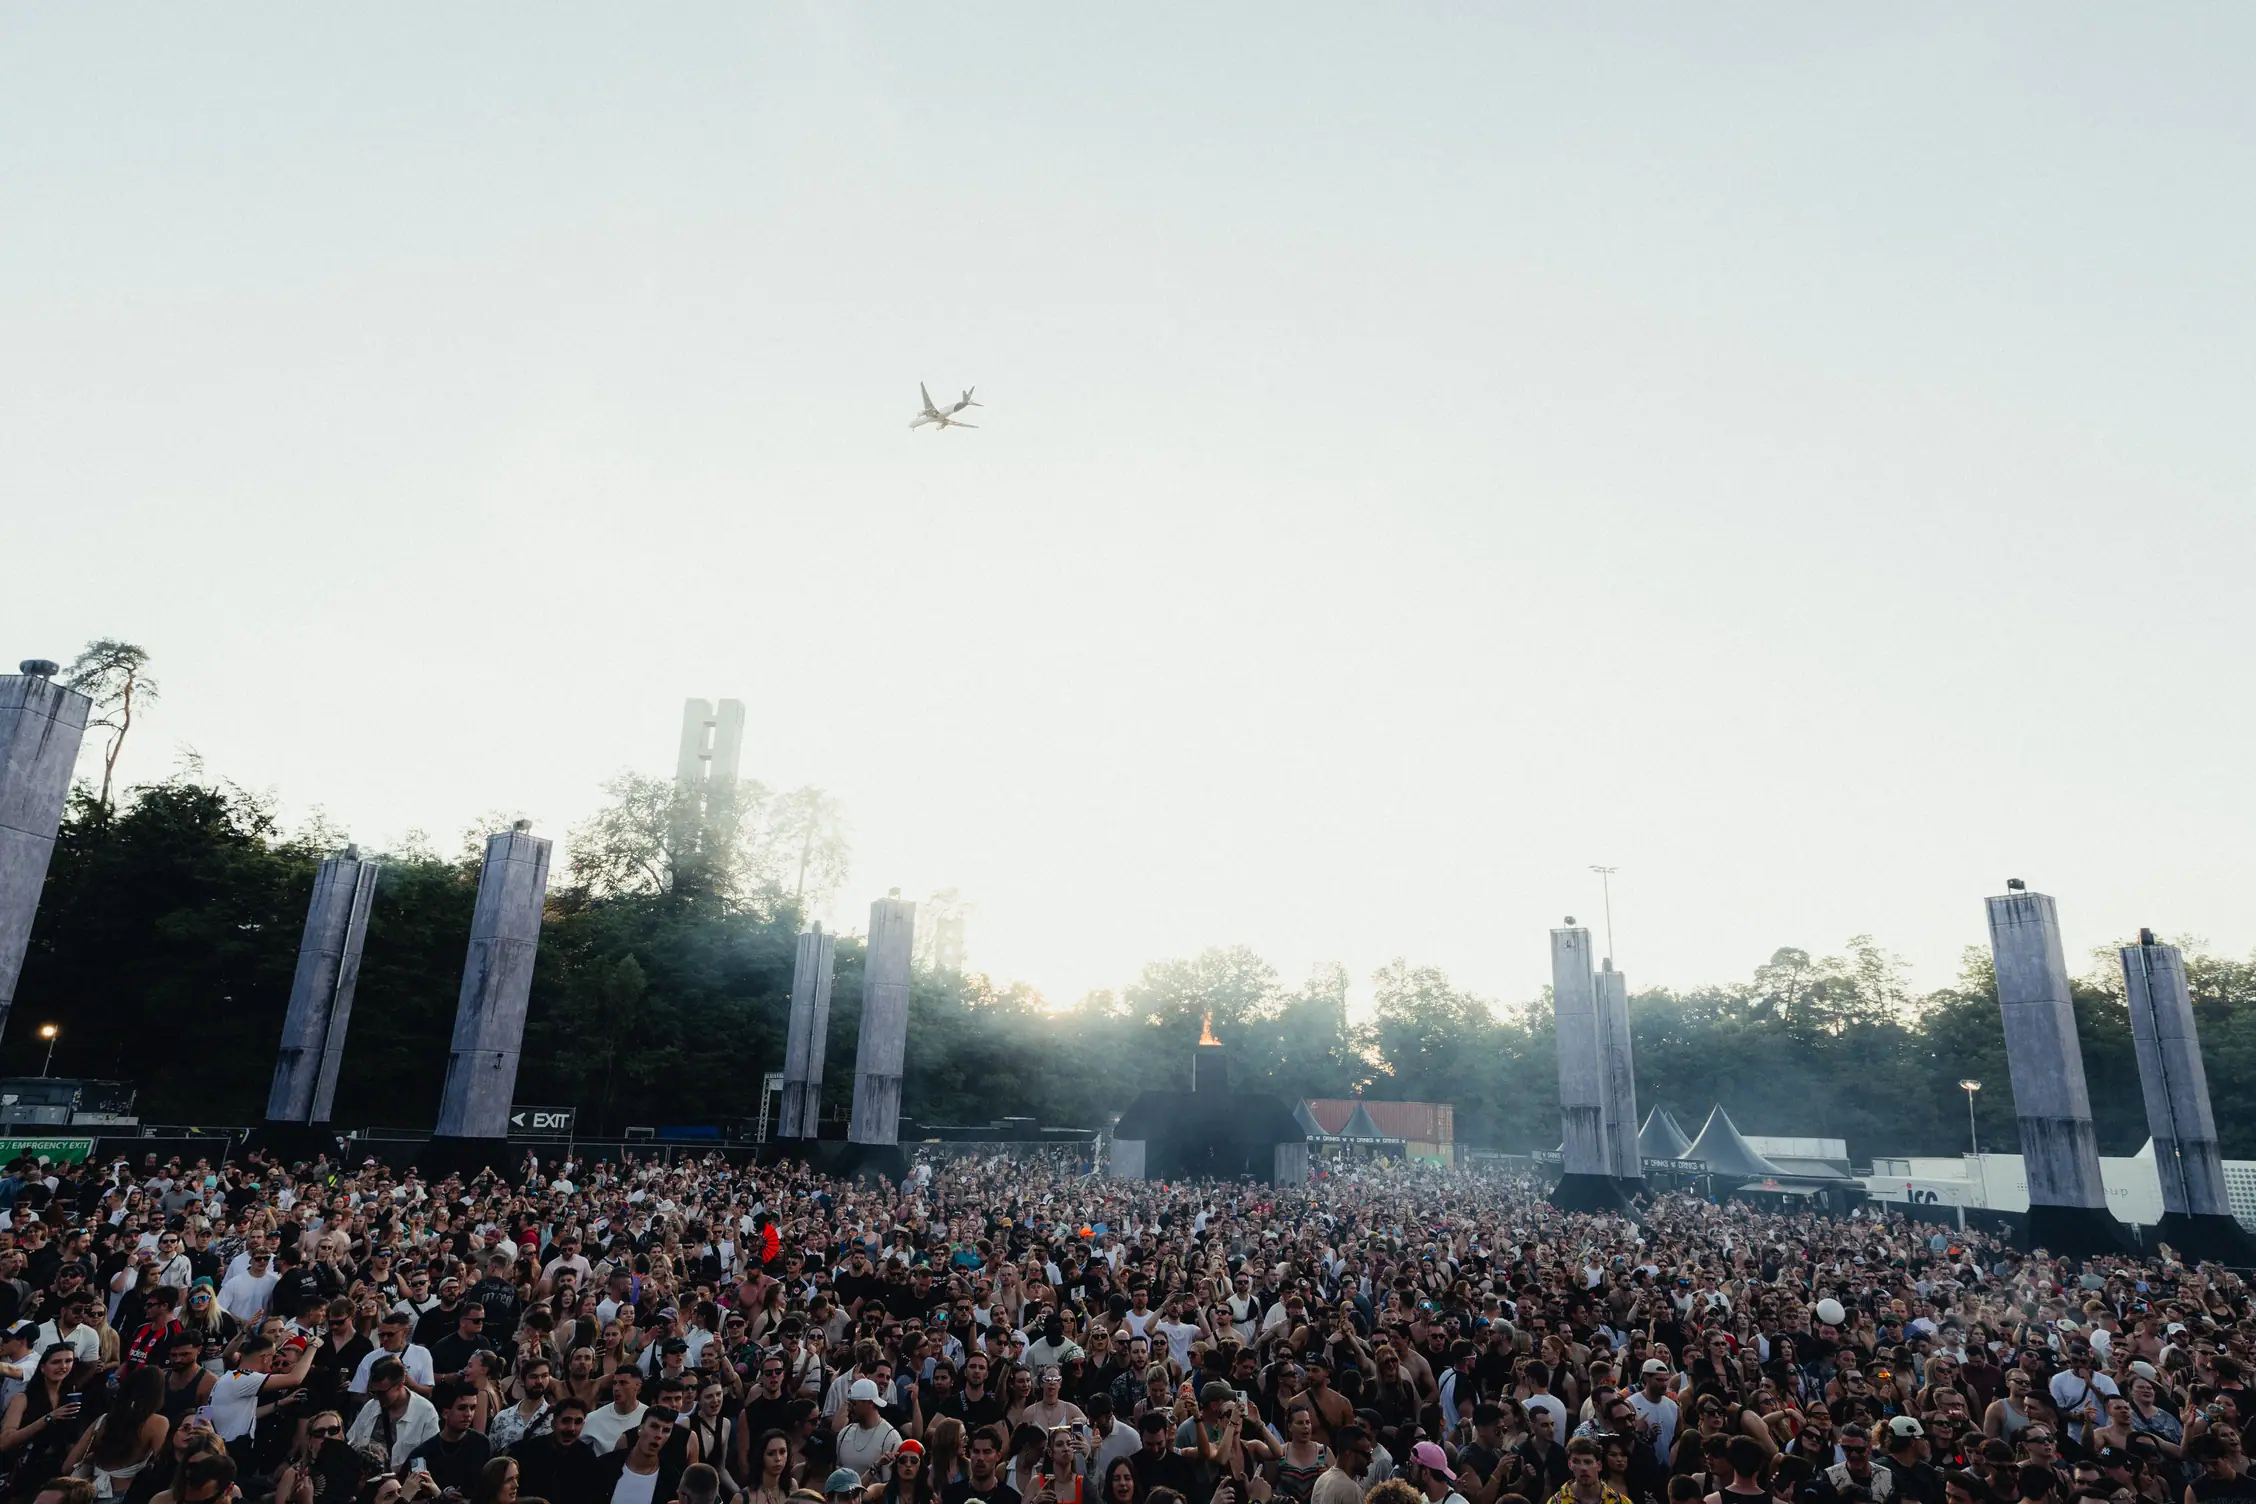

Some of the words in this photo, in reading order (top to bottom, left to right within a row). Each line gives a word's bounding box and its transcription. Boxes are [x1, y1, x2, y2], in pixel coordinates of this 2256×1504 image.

[533, 1112, 570, 1128] EXIT
[12, 1141, 68, 1149] EMERGENCY
[69, 1141, 89, 1149] EXIT
[1650, 1159, 1669, 1168] DRINKS
[1677, 1161, 1698, 1170] DRINKS
